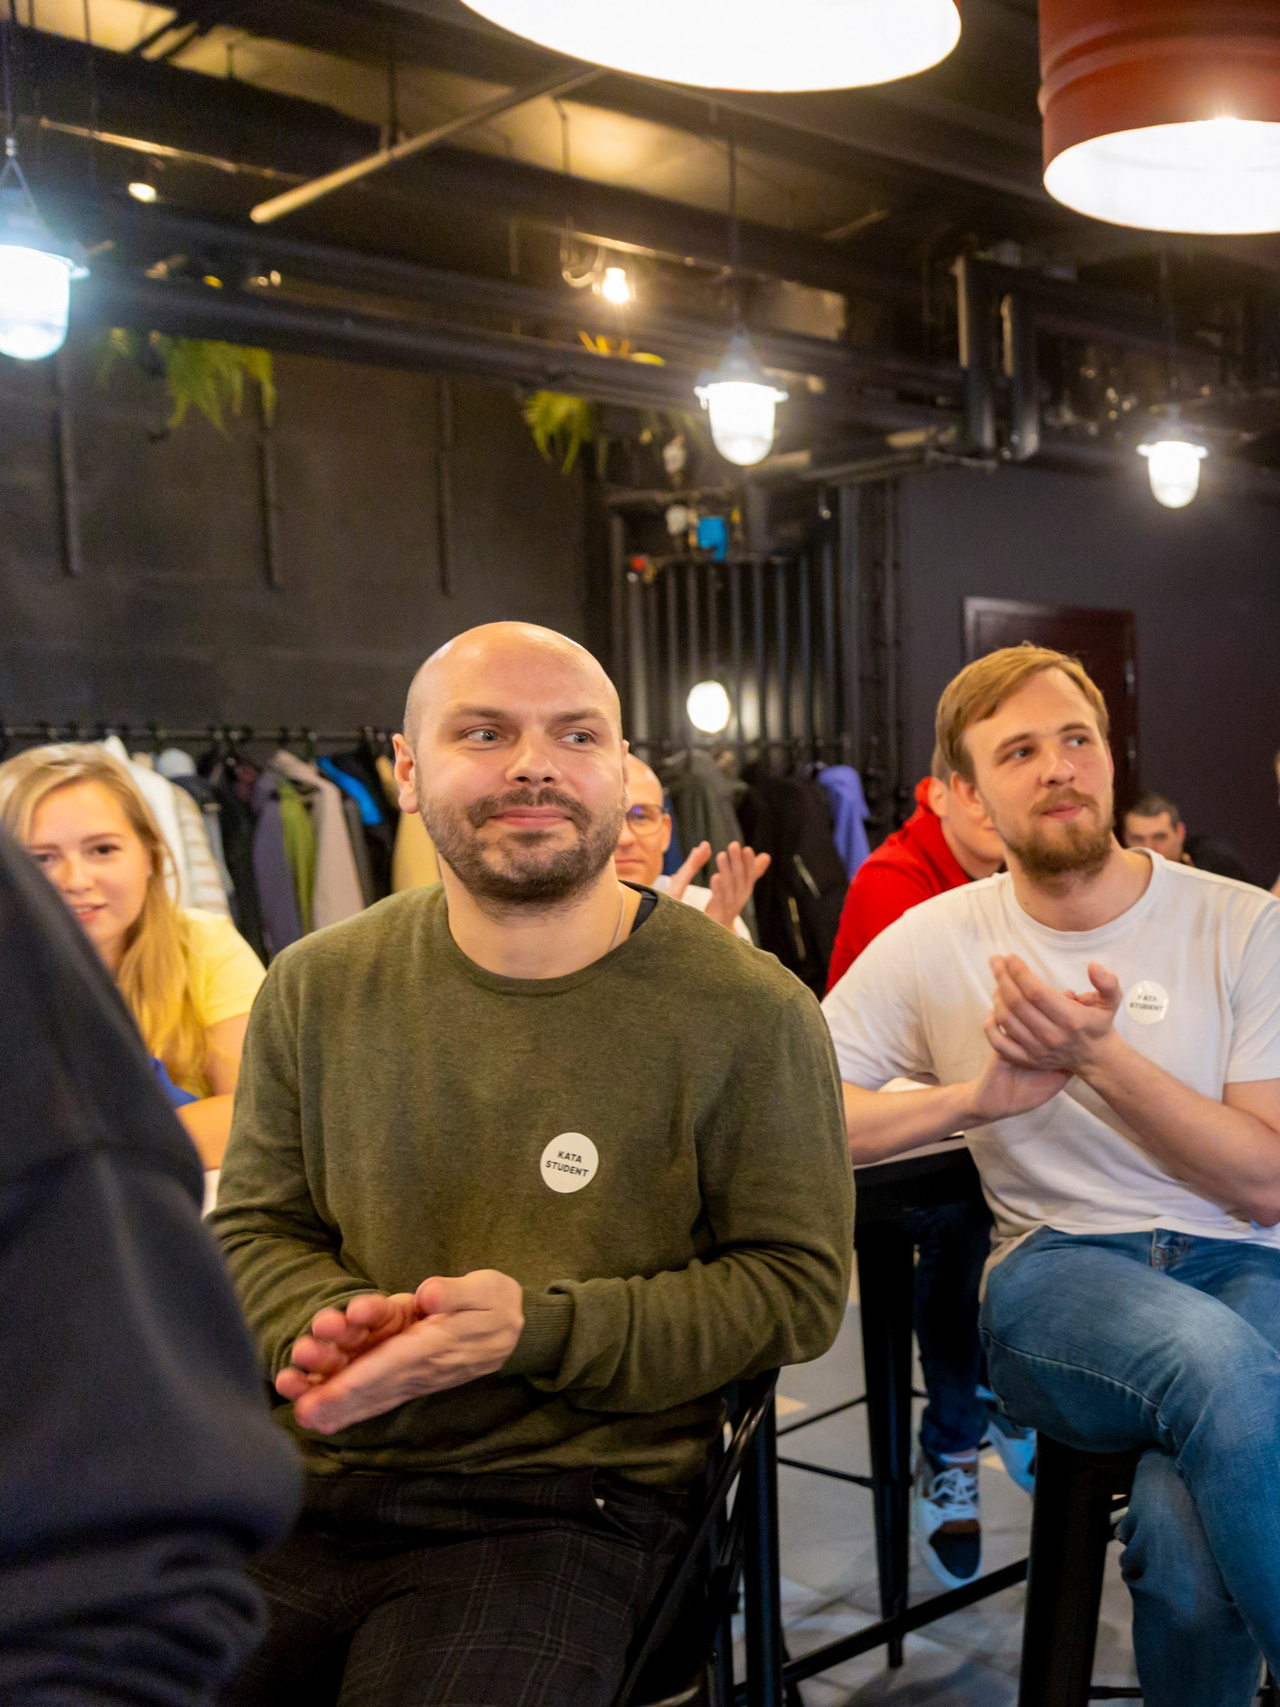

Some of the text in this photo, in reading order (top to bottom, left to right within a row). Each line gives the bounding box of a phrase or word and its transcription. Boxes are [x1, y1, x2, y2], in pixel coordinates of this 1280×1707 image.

[1129, 1002, 1163, 1011] STUDENT
[557, 1150, 582, 1163] KATA
[546, 1160, 589, 1177] STUDENT
